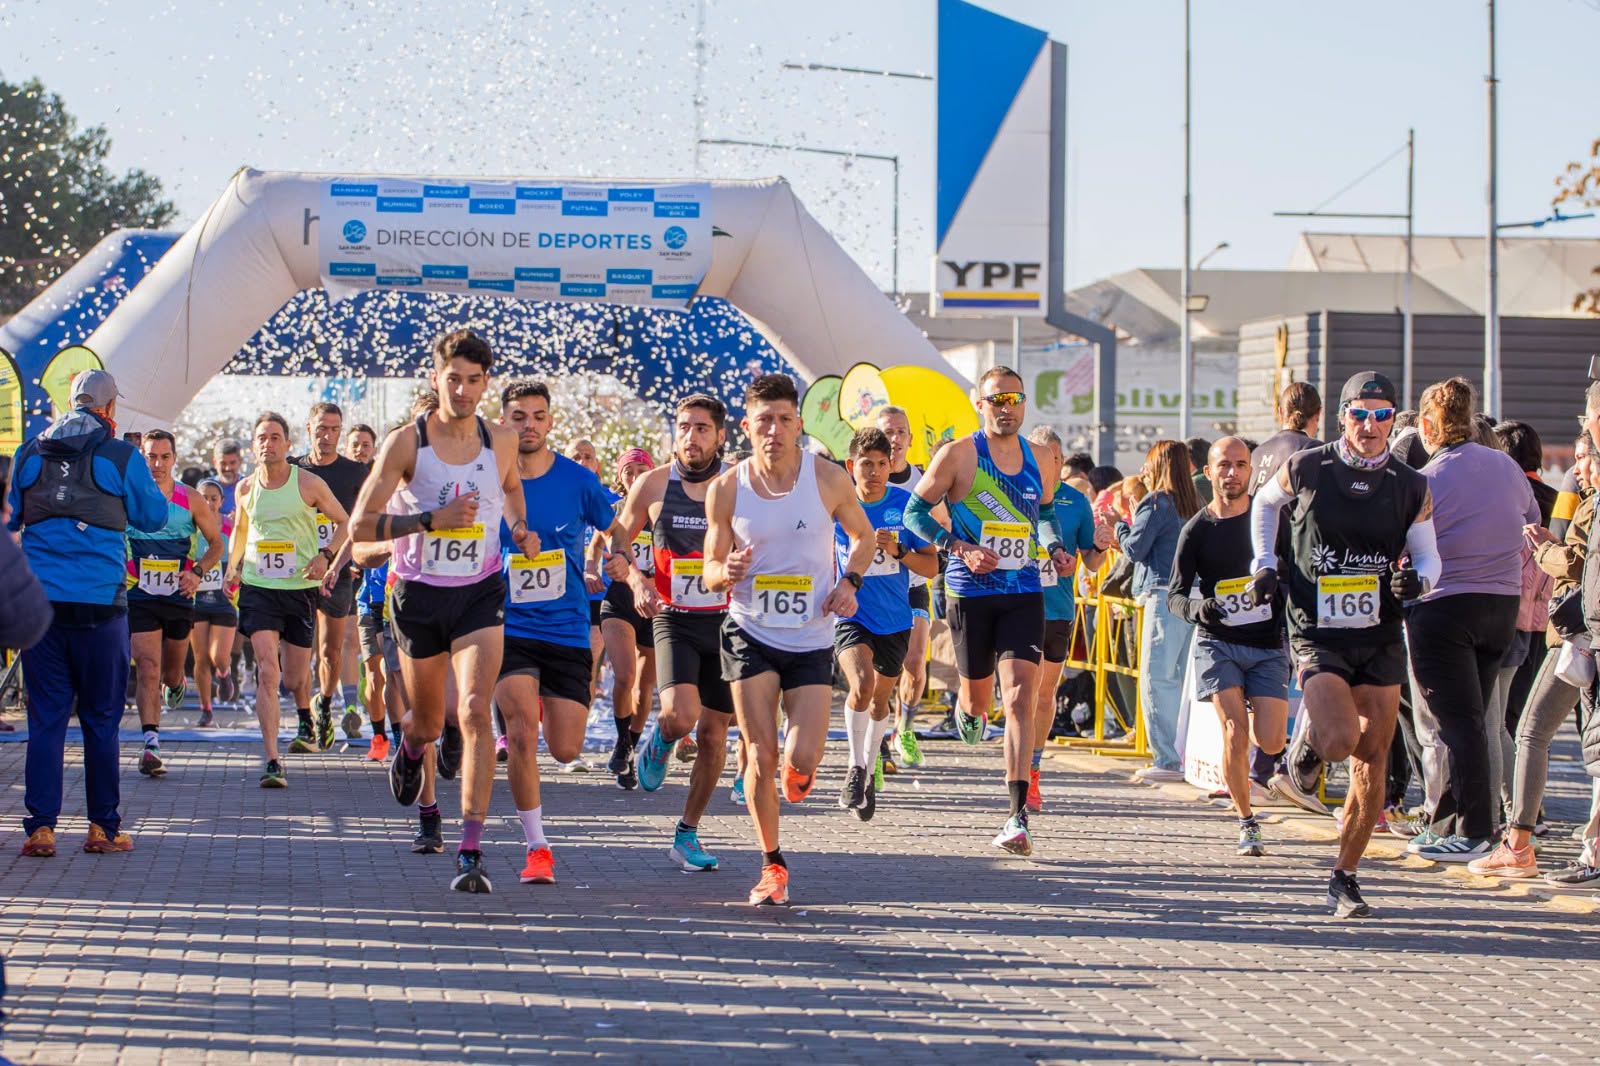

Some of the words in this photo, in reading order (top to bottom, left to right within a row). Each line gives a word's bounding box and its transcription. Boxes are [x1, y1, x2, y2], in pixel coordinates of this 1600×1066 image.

[377, 227, 495, 247] DIRECCIÓN
[503, 232, 531, 248] DE
[538, 232, 652, 250] DEPORTES
[943, 261, 1041, 288] YPF
[317, 524, 328, 540] 9
[430, 538, 479, 562] 164
[631, 542, 651, 561] 31
[985, 536, 1025, 559] 188
[263, 553, 285, 569] 15
[1041, 560, 1054, 576] 4
[143, 570, 175, 586] 114
[200, 568, 221, 584] 62
[520, 568, 551, 590] 20
[758, 590, 808, 615] 165
[1324, 592, 1374, 617] 166
